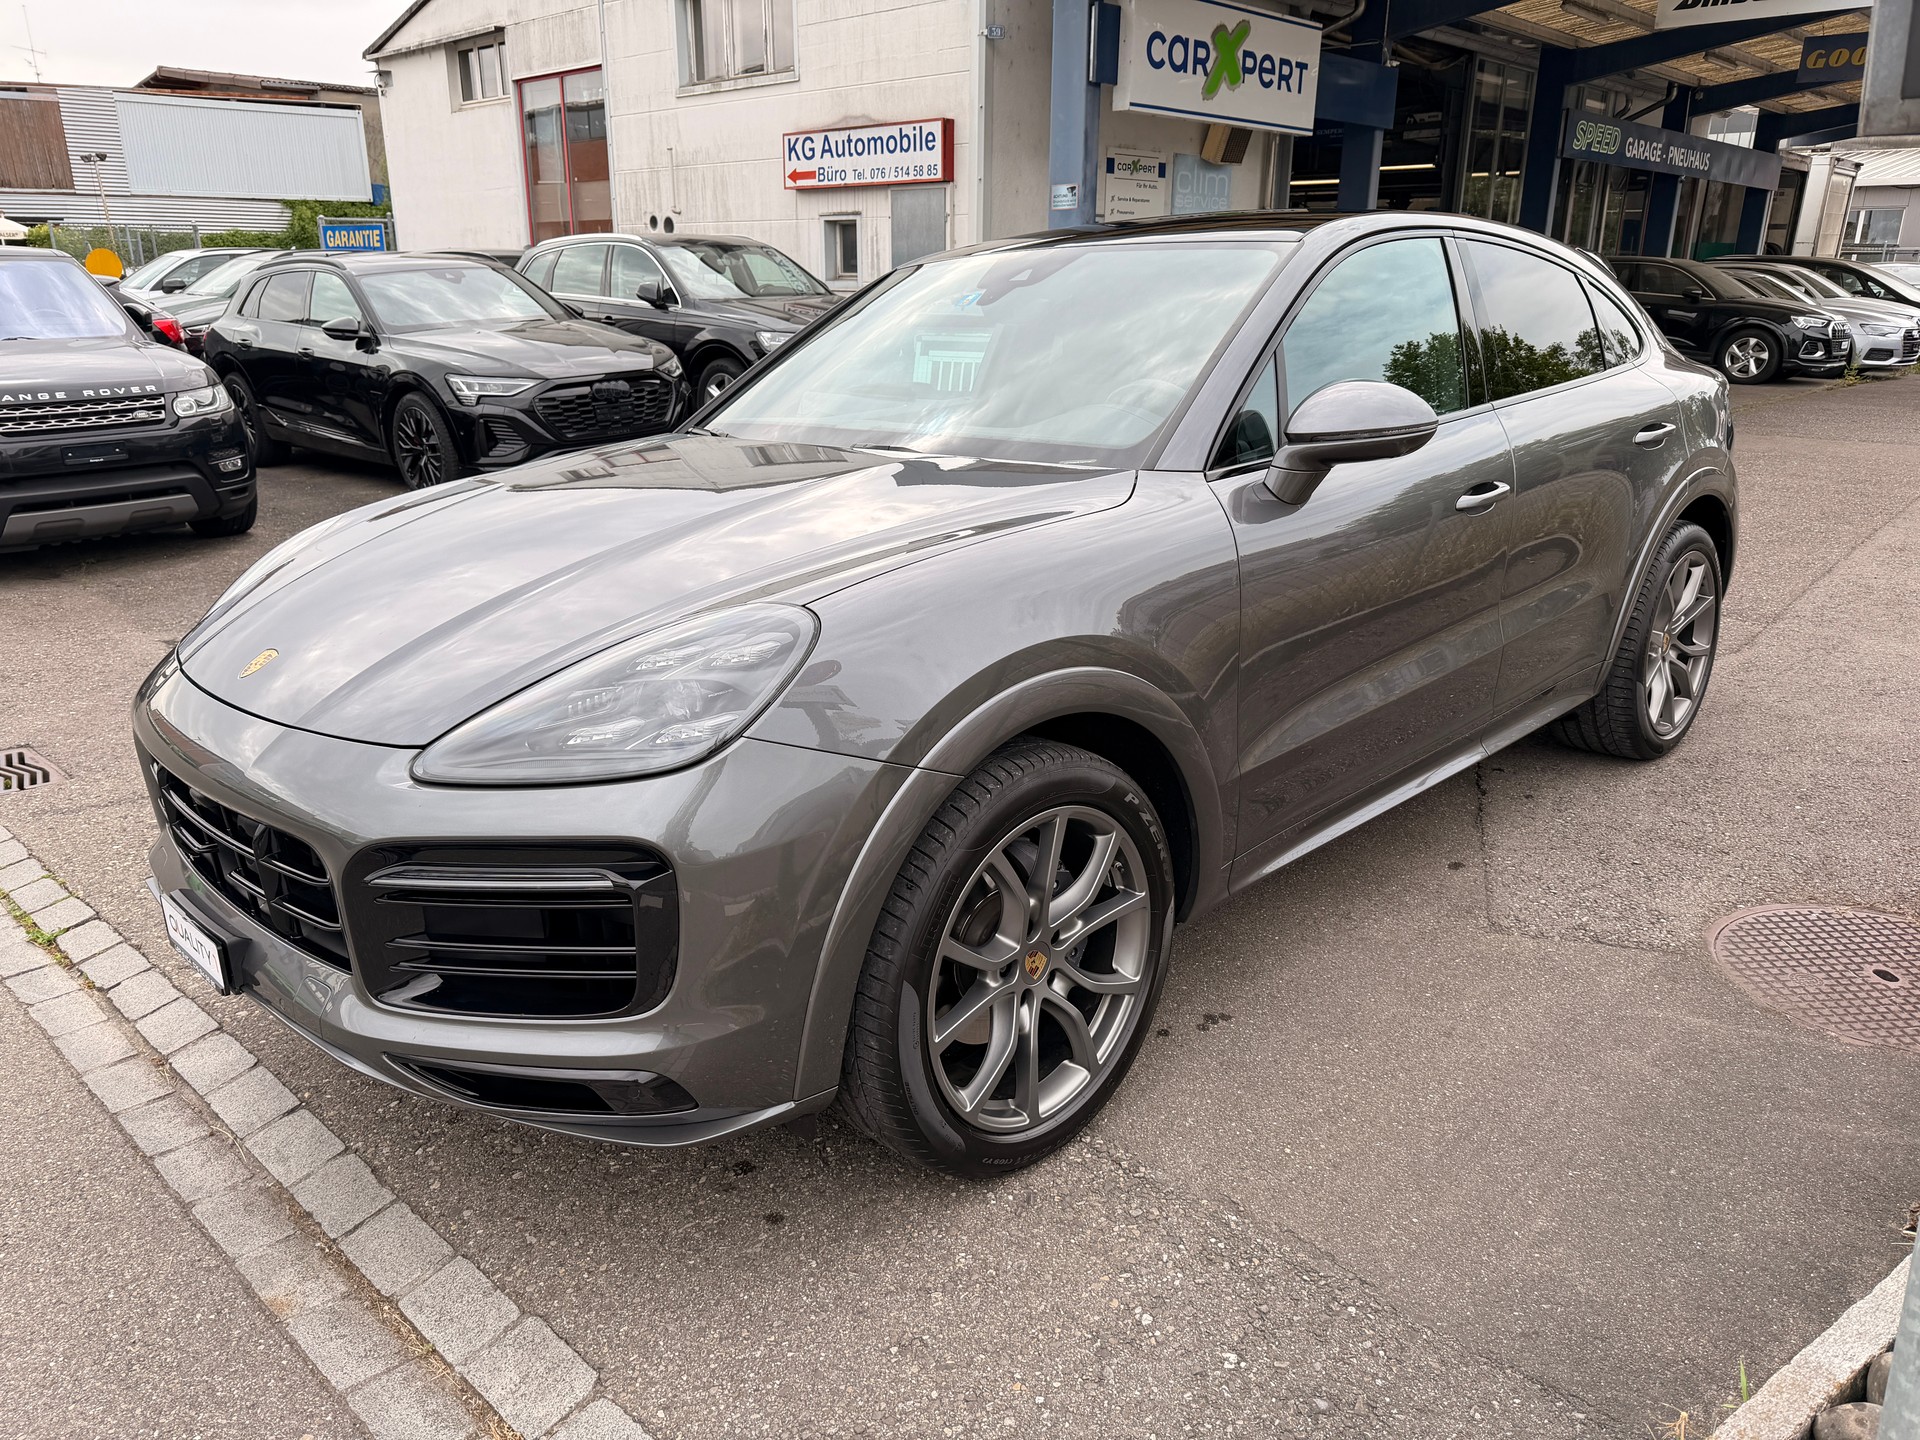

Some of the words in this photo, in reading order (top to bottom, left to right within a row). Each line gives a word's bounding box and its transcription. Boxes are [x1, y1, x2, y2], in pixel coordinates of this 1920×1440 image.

[787, 135, 816, 162] KG
[819, 125, 937, 160] Automobile
[1572, 119, 1622, 155] SPEED
[1625, 136, 1662, 163] GARAGE
[1667, 145, 1711, 172] PNEUHAUS
[817, 165, 848, 183] Büro
[852, 168, 868, 181] Tel.
[870, 167, 886, 180] 076
[893, 165, 910, 178] 514
[913, 164, 924, 177] 58
[926, 163, 939, 177] 85
[1177, 162, 1229, 197] clim
[1174, 193, 1228, 210] service
[326, 229, 381, 248] GARANTIE
[82, 384, 158, 397] ROVER
[1123, 792, 1140, 806] P
[1138, 807, 1173, 882] ZERO
